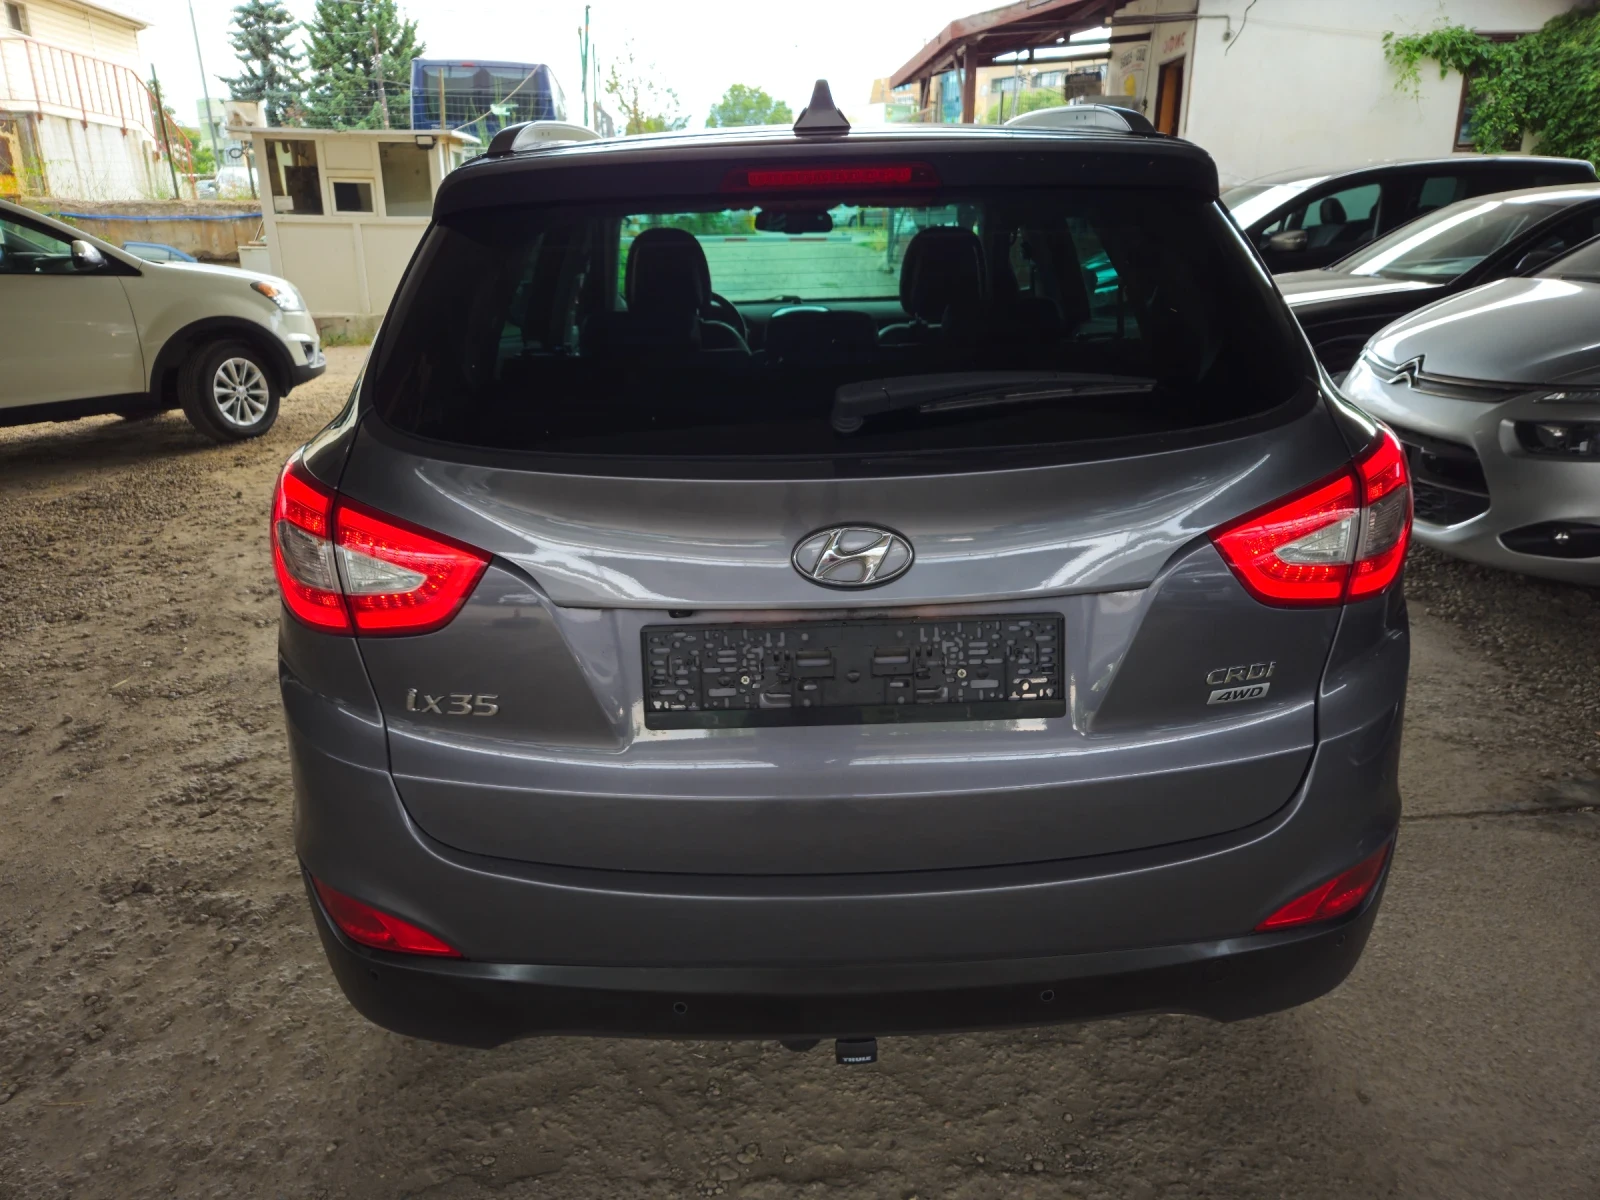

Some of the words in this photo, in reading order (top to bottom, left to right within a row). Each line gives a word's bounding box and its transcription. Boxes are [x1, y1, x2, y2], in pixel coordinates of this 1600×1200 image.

[1206, 661, 1276, 685] CRDi
[406, 688, 499, 716] ix35
[1216, 686, 1264, 701] 4WD
